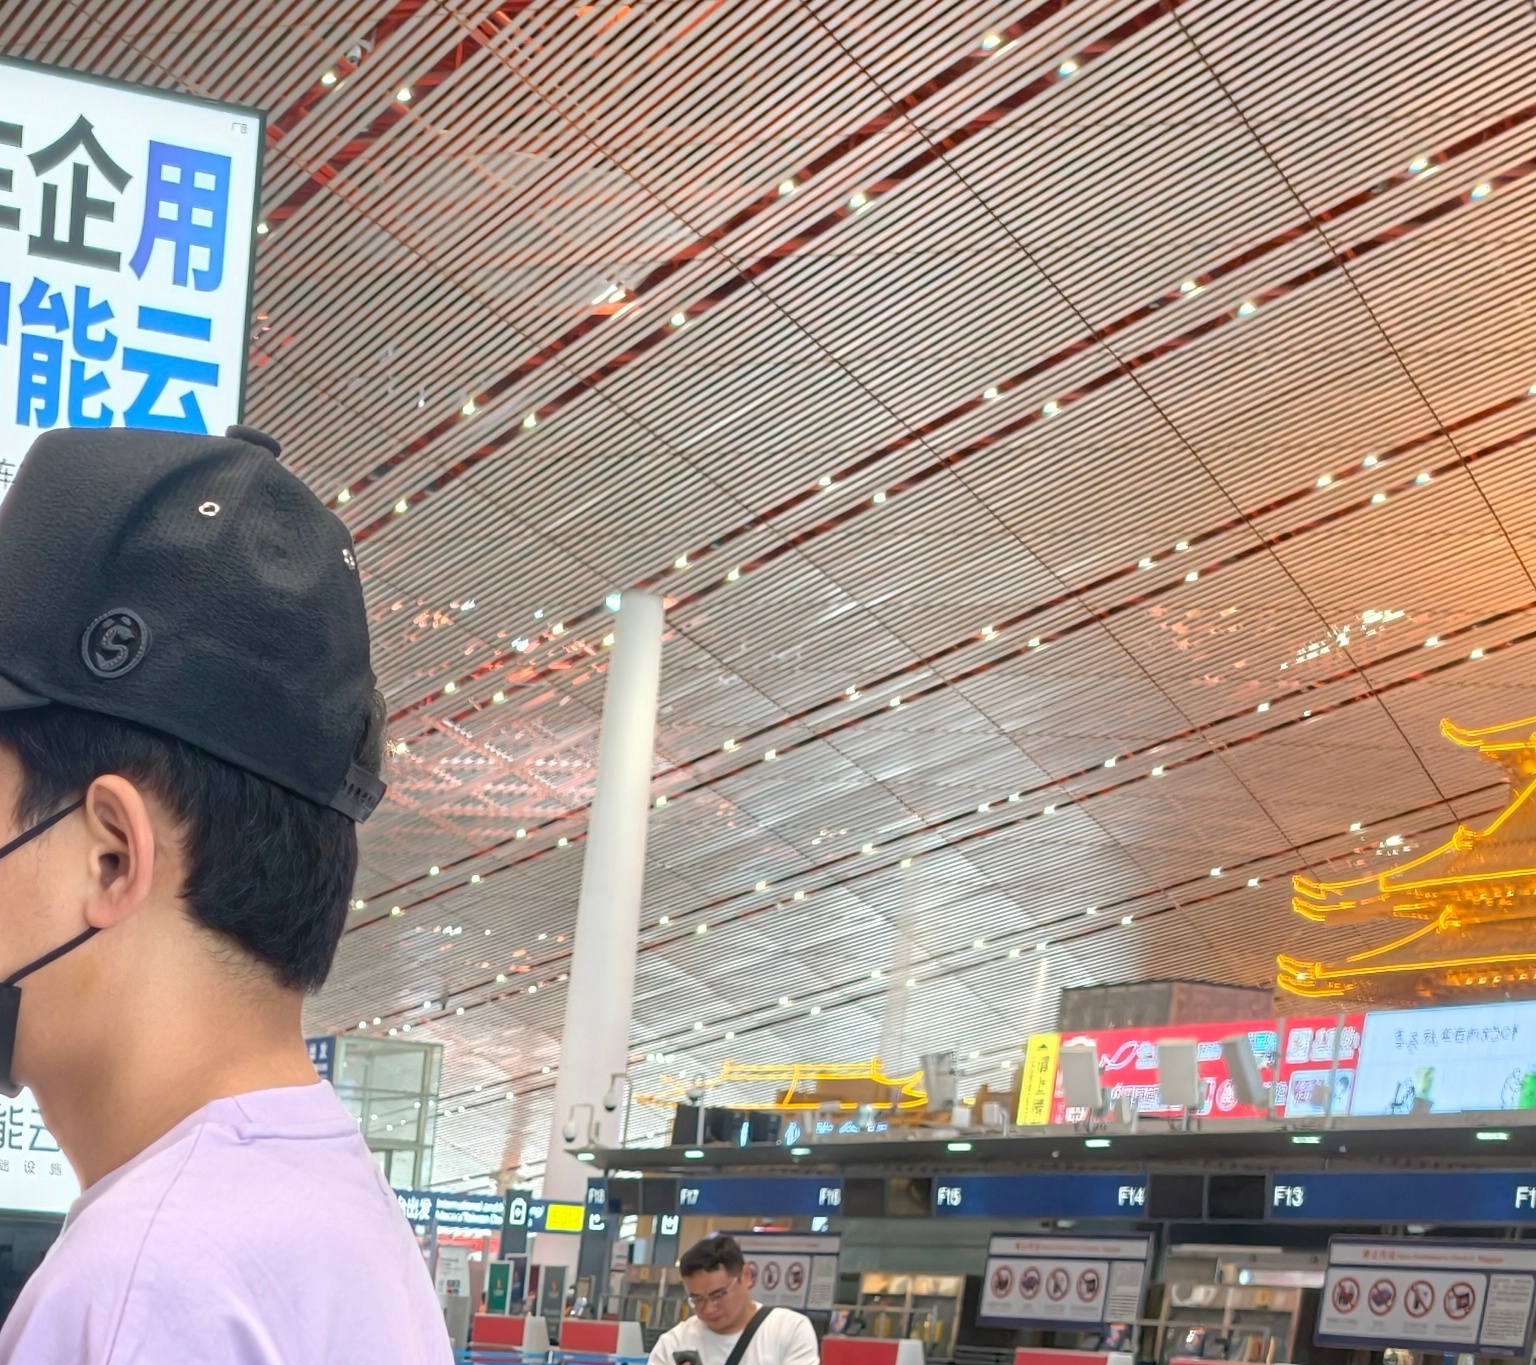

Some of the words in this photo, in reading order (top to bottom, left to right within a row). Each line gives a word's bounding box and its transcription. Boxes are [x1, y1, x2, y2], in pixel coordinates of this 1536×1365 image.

[679, 1187, 700, 1206] F17
[1118, 1185, 1146, 1206] F14
[1273, 1185, 1304, 1207] F13
